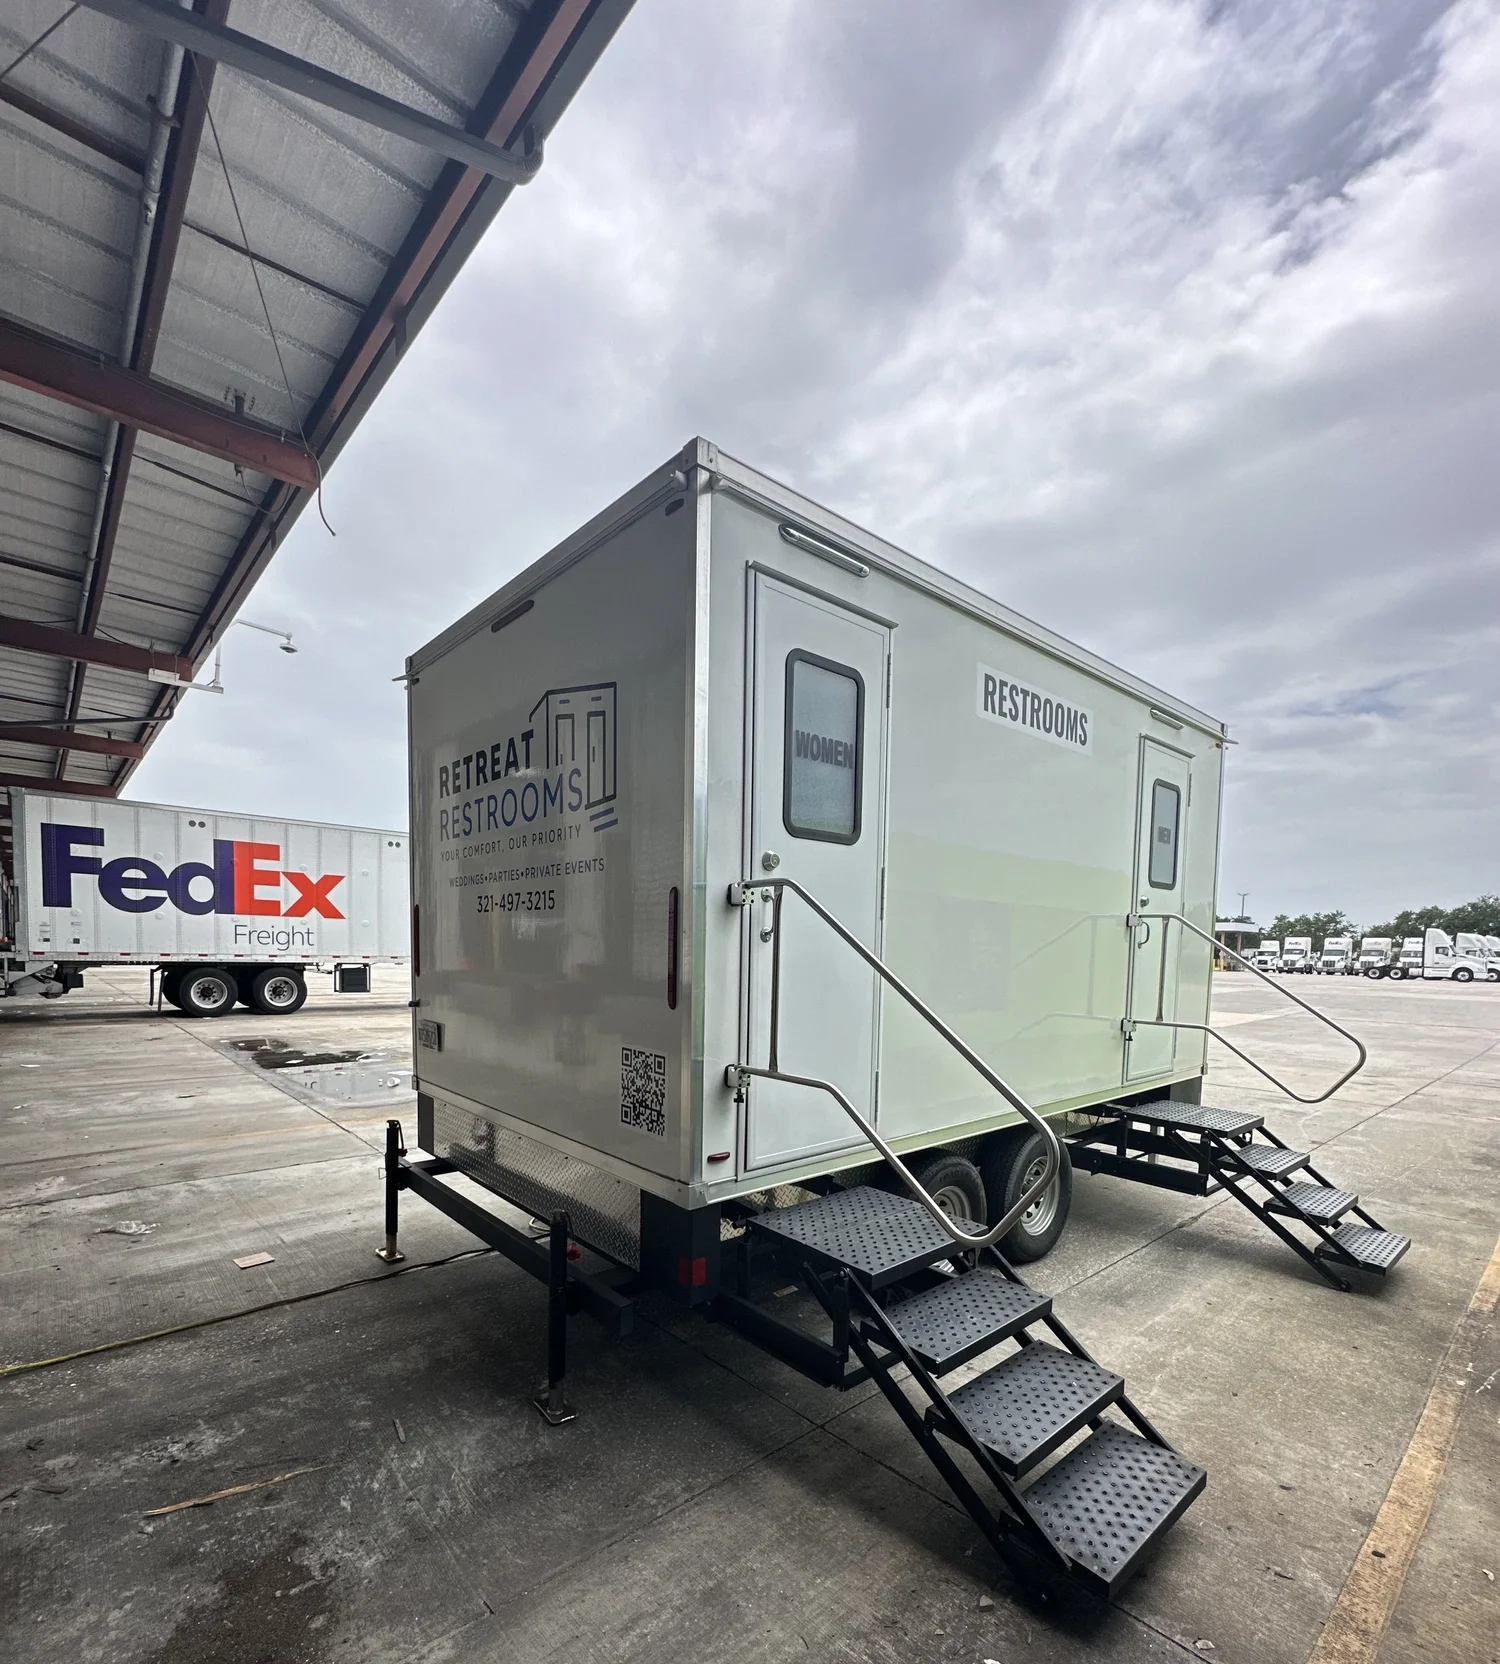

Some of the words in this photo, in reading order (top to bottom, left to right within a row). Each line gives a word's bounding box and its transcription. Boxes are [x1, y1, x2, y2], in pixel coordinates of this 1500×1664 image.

[983, 672, 1088, 747] RESTROOMS
[439, 728, 534, 799] RETREAT
[795, 729, 853, 770] WOMEN
[440, 767, 583, 842] RESTROOMS
[440, 850, 460, 862] YOUR
[508, 835, 528, 850] OUR
[532, 824, 582, 846] PRIORITY
[40, 822, 347, 920] FedEx
[565, 858, 605, 875] EVENTS
[477, 889, 555, 913] 321-497-3215
[233, 924, 315, 951] Freight
